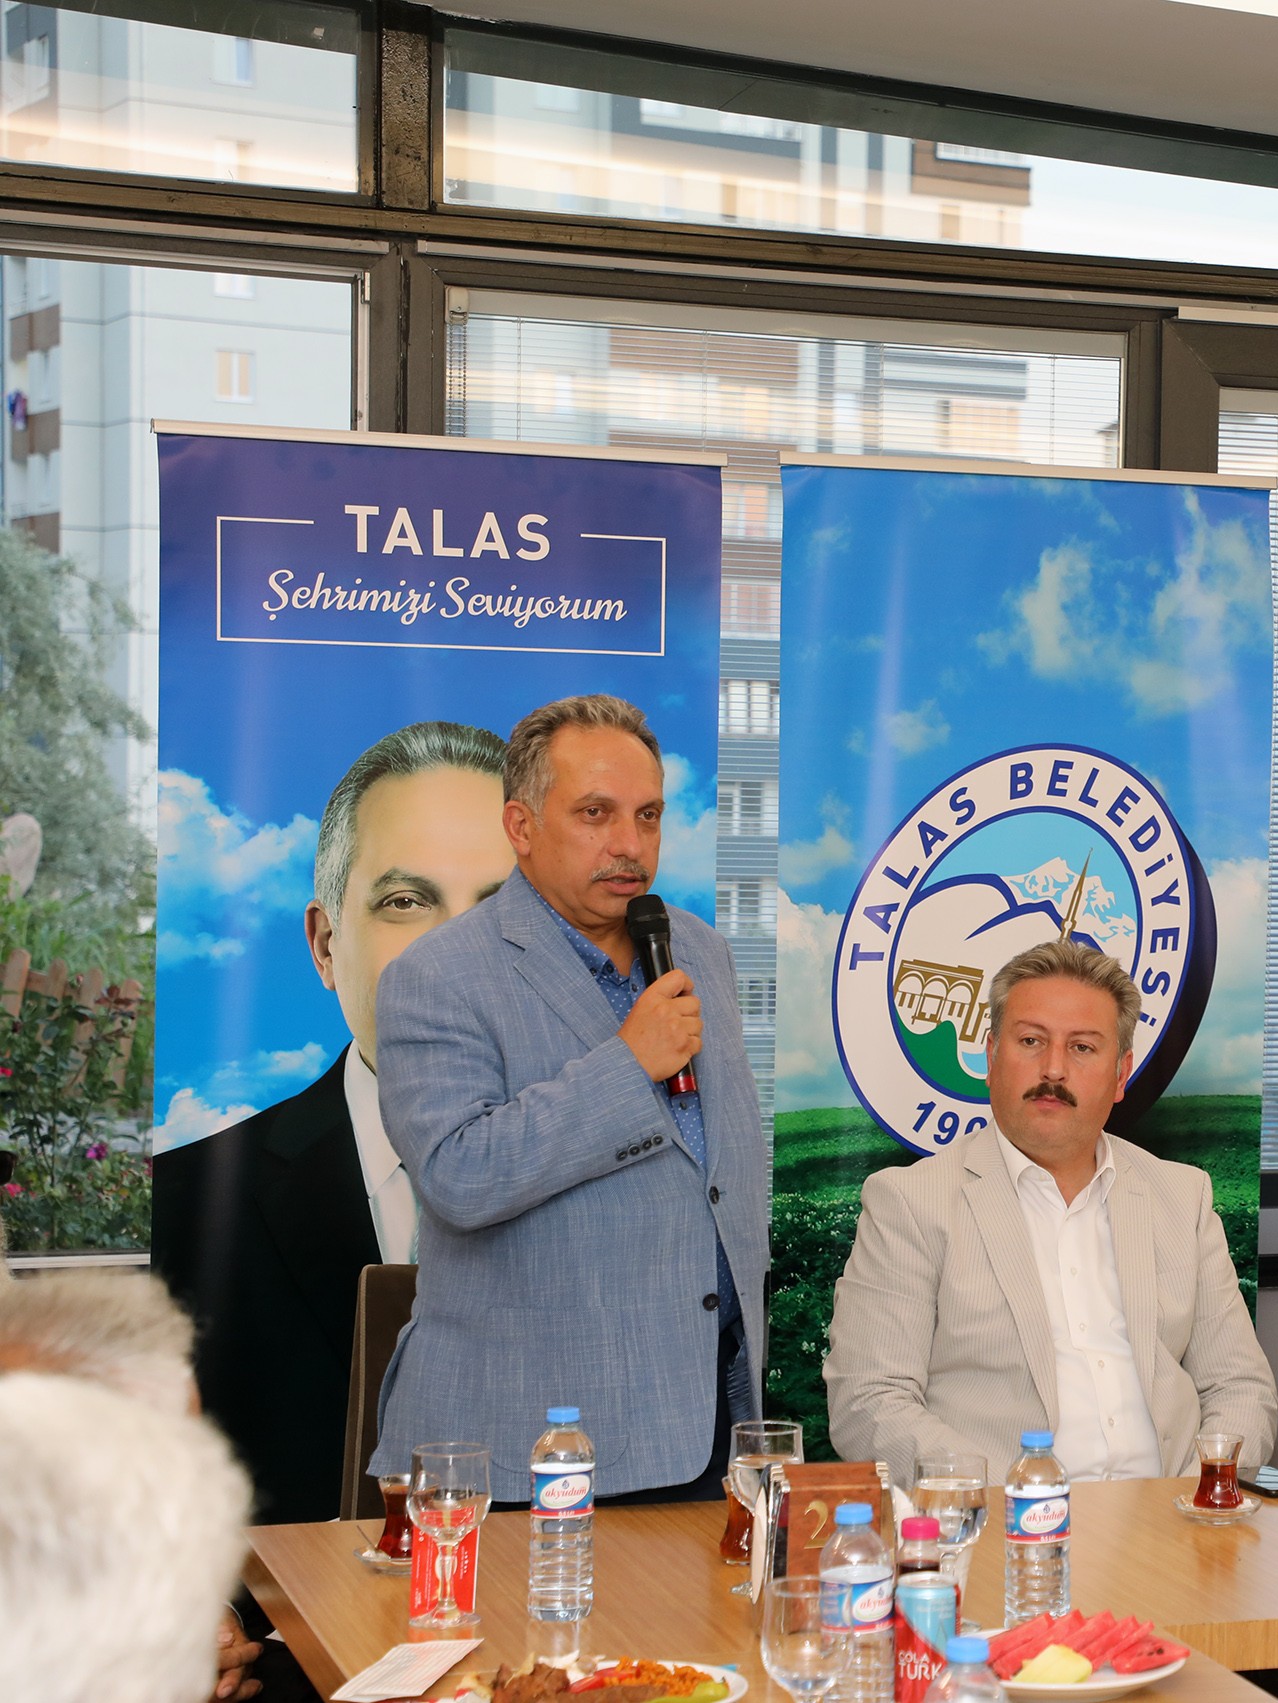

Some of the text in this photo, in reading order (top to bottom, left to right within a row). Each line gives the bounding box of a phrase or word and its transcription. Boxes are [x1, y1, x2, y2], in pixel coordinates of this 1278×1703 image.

[344, 504, 551, 562] TALAS
[262, 568, 627, 629] Şehrimizi Seviyorum
[849, 786, 976, 971] TALAS
